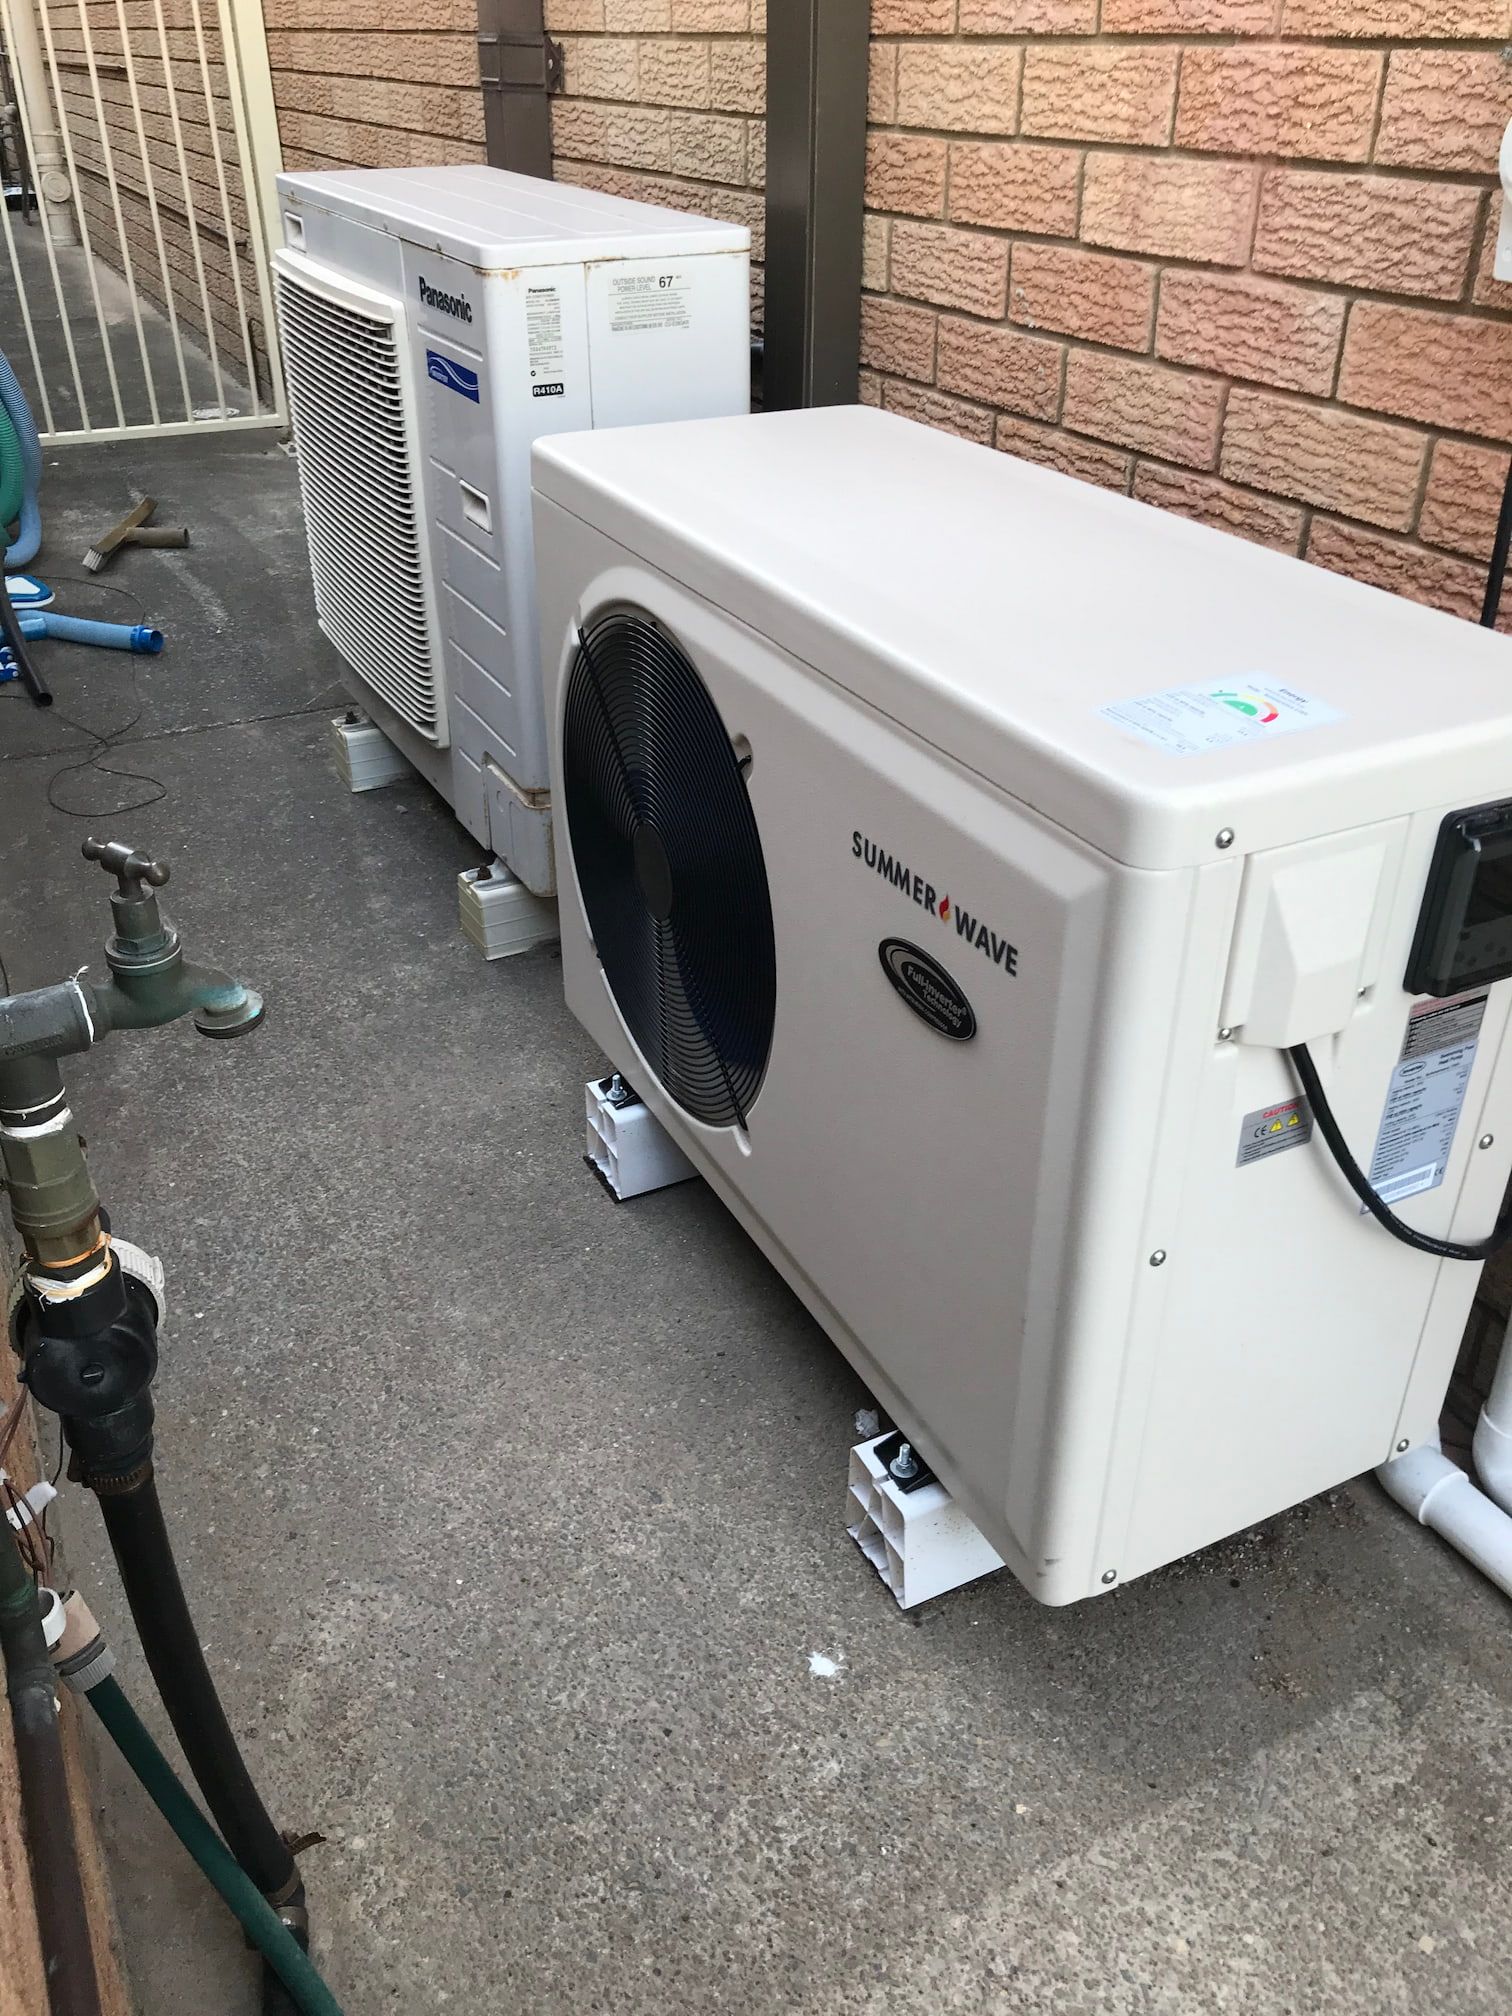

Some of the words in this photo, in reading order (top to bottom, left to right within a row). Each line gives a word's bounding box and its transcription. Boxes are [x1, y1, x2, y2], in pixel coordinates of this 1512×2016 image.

[418, 275, 473, 323] Panasonic
[658, 275, 674, 288] 67
[533, 384, 563, 396] R410A
[852, 831, 936, 916] SUMMER
[955, 904, 1018, 977] WAVE
[923, 989, 961, 1029] Technology
